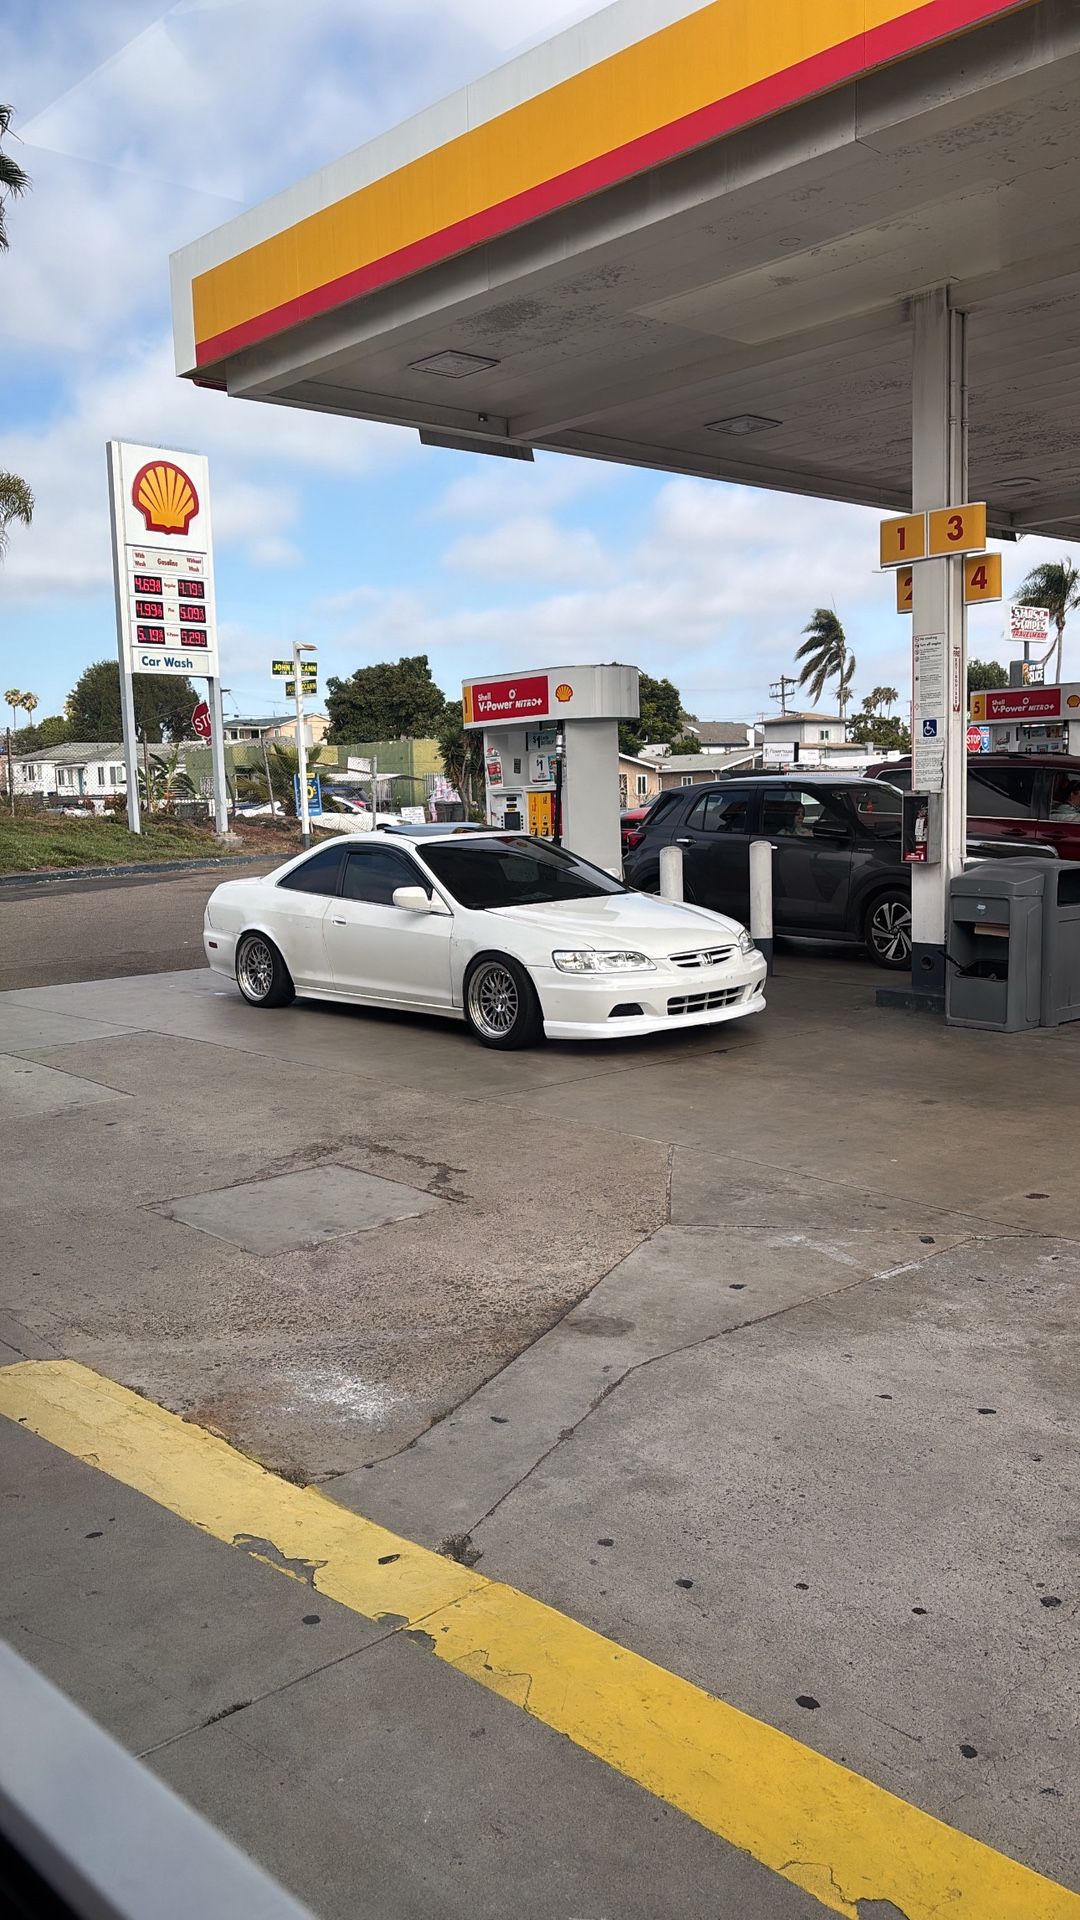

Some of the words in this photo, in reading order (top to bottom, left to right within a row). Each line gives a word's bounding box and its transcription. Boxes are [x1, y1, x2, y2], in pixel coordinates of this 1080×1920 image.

[947, 515, 963, 541] 3
[897, 527, 905, 550] 1
[157, 558, 178, 567] Gasoline
[970, 565, 987, 590] 4
[141, 655, 161, 666] Car
[164, 656, 193, 668] Wash
[273, 663, 292, 672] JOHN
[477, 692, 492, 702] Shell
[991, 698, 1006, 706] Shell
[478, 700, 513, 712] V-Power
[515, 698, 543, 708] NITRO+
[973, 701, 980, 714] 5
[991, 704, 1026, 713] V-Power
[967, 735, 981, 744] STOP
